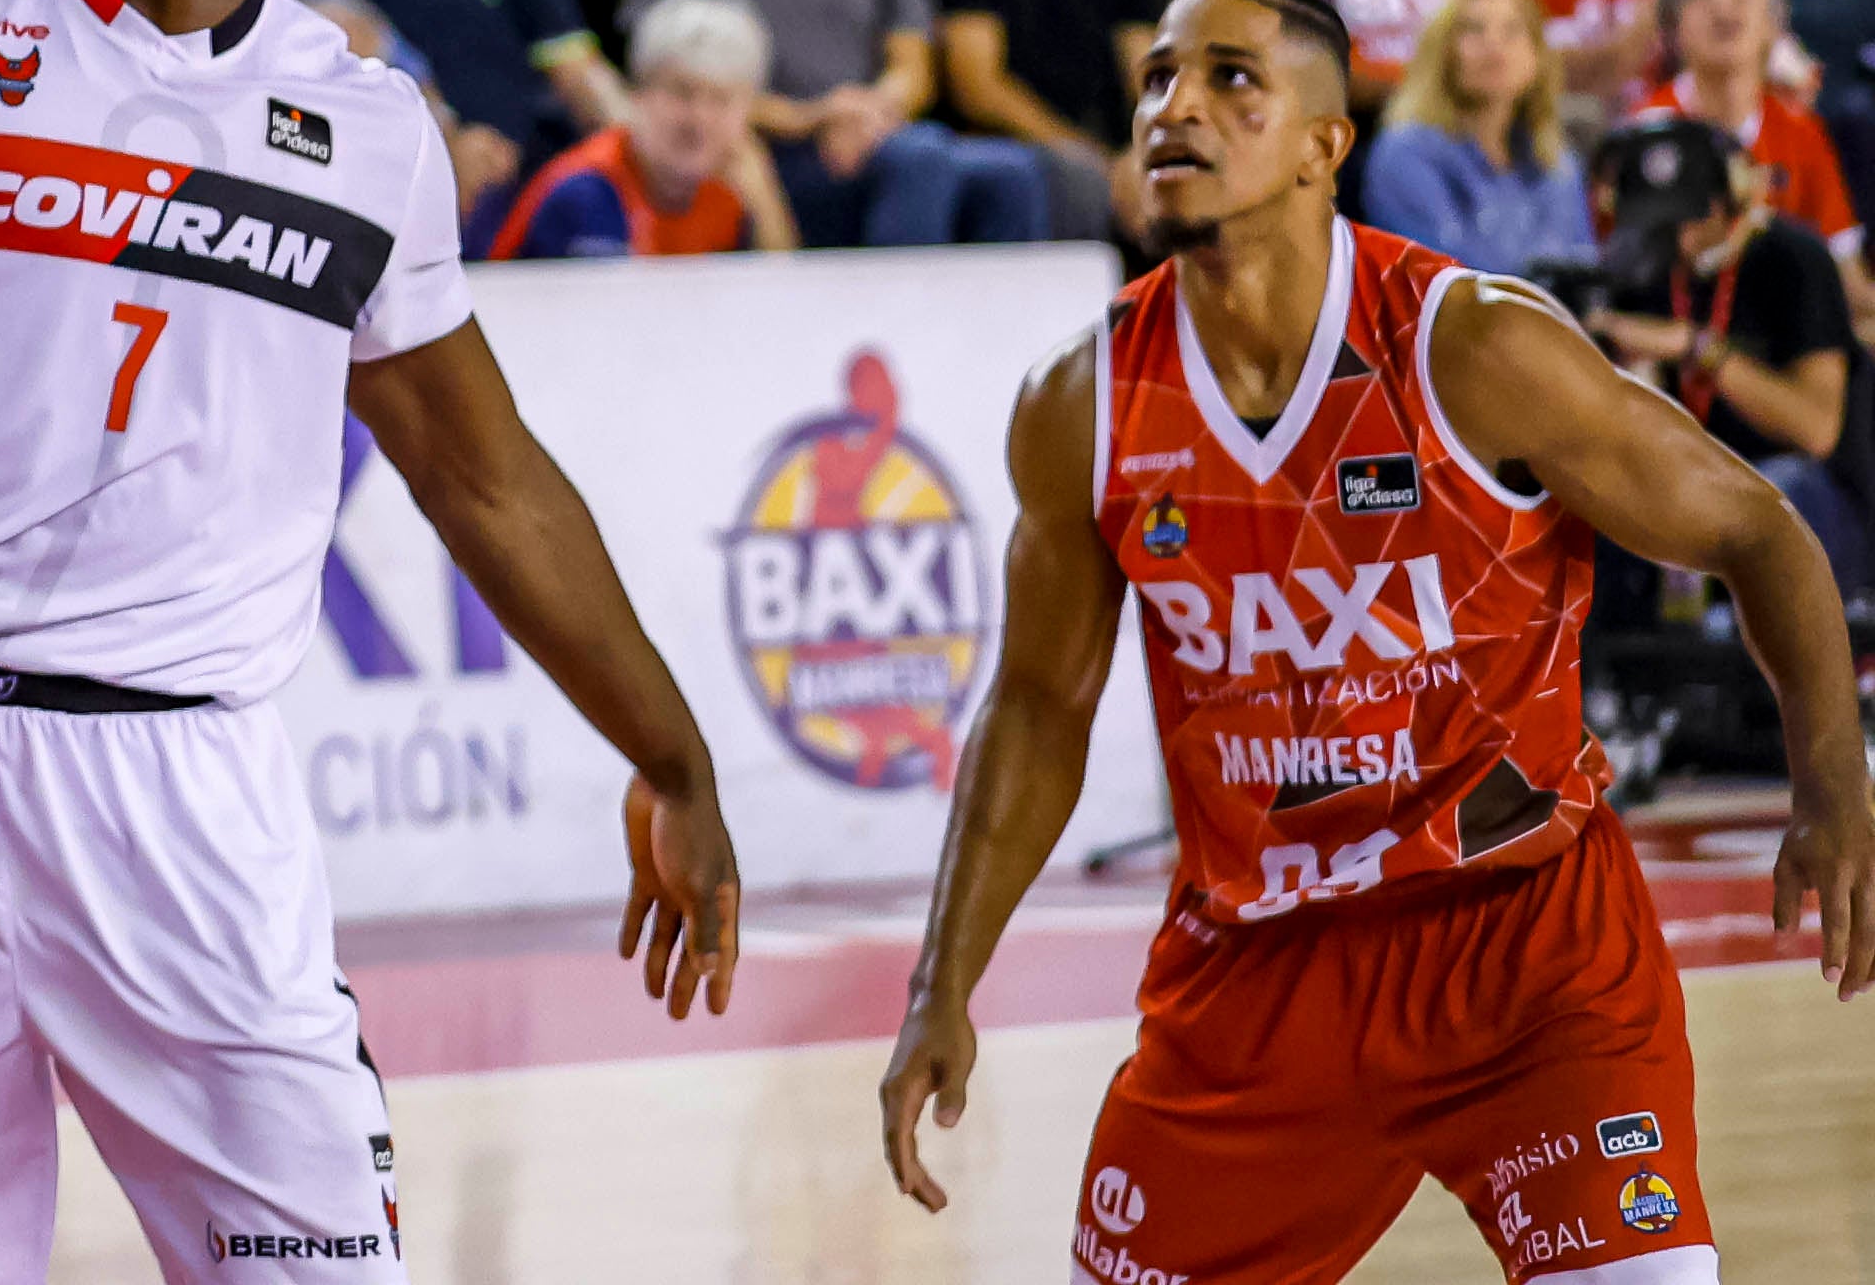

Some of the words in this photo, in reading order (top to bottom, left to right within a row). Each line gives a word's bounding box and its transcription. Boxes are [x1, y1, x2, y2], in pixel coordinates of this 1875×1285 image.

[103, 299, 169, 433] 7
[741, 525, 981, 642] BAXI
[1139, 553, 1457, 676] BAXI
[1214, 728, 1420, 785] MANRESA
[1607, 1130, 1650, 1153] acb
[228, 1233, 382, 1259] BERNER
